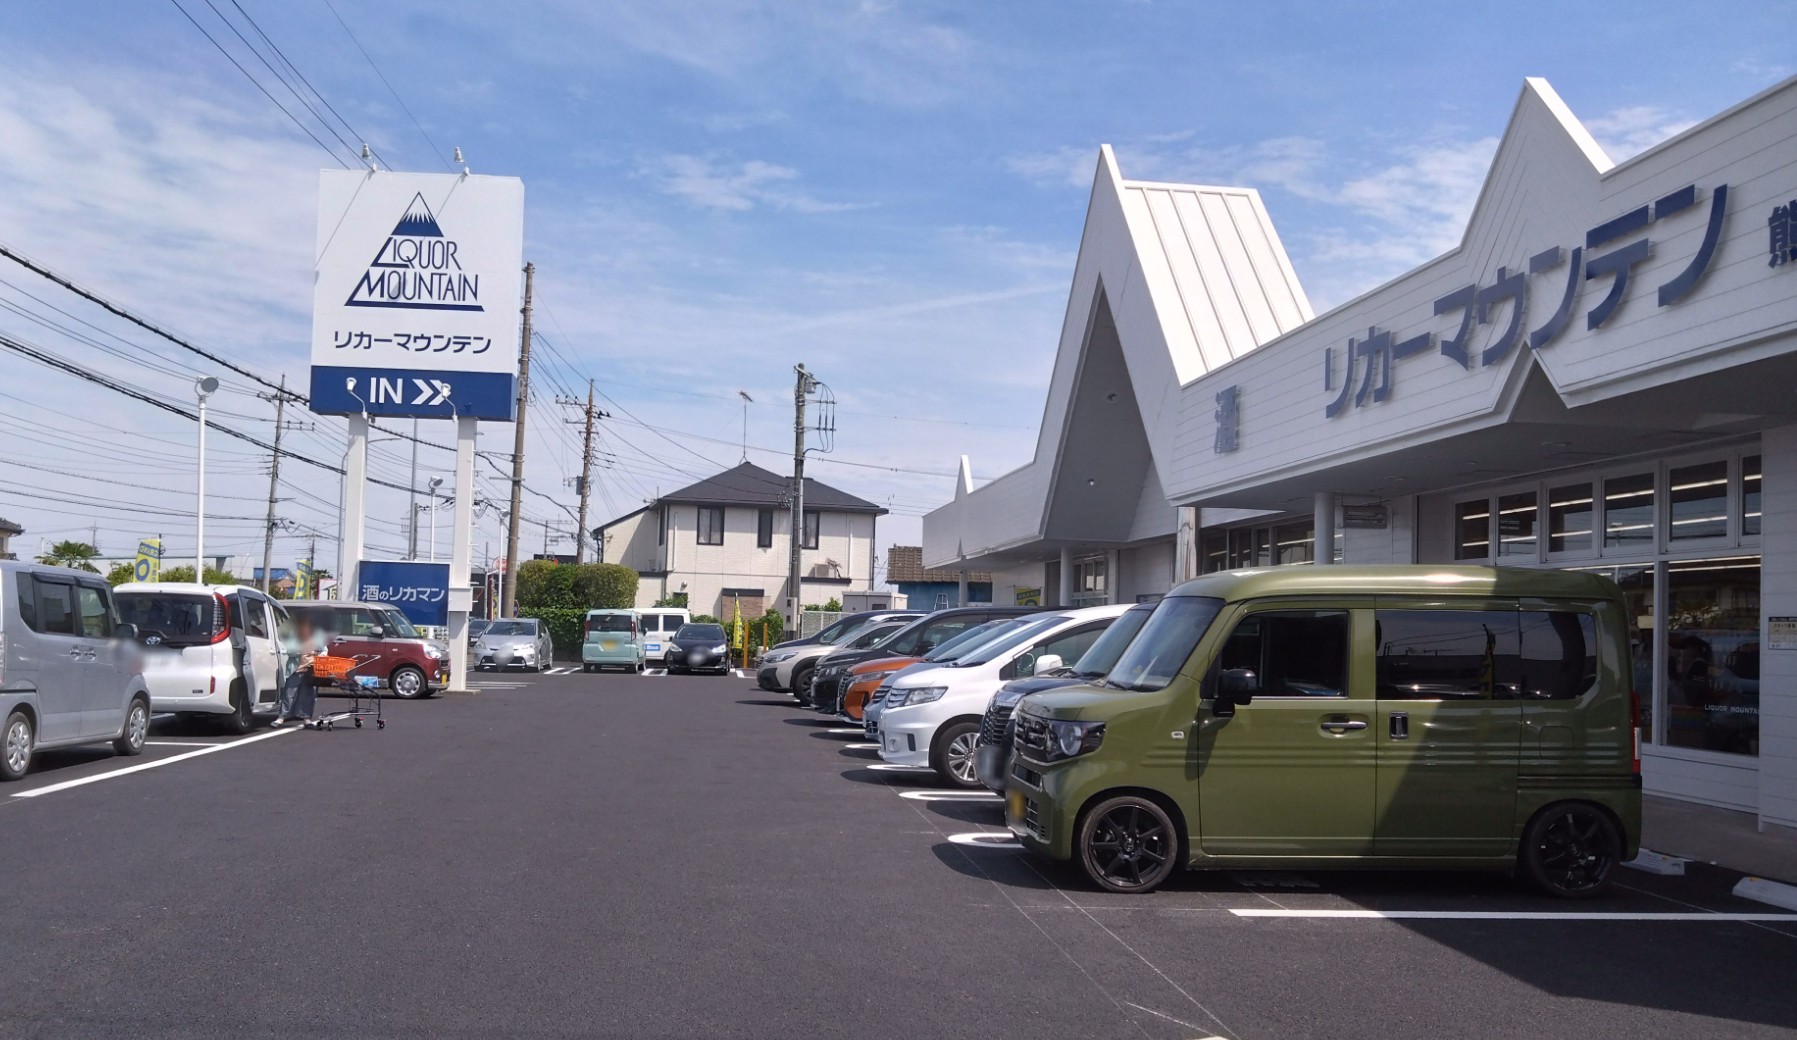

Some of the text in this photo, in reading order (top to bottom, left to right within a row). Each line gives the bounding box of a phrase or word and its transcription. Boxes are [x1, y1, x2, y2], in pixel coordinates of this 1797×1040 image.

[370, 237, 462, 270] LIQUOR
[344, 269, 480, 307] MOUNTAIN
[1325, 184, 1727, 418] リカーマウンテン
[334, 331, 491, 353] リカーマウンテン
[370, 377, 403, 403] IN
[362, 584, 445, 602] 酒のリカマン
